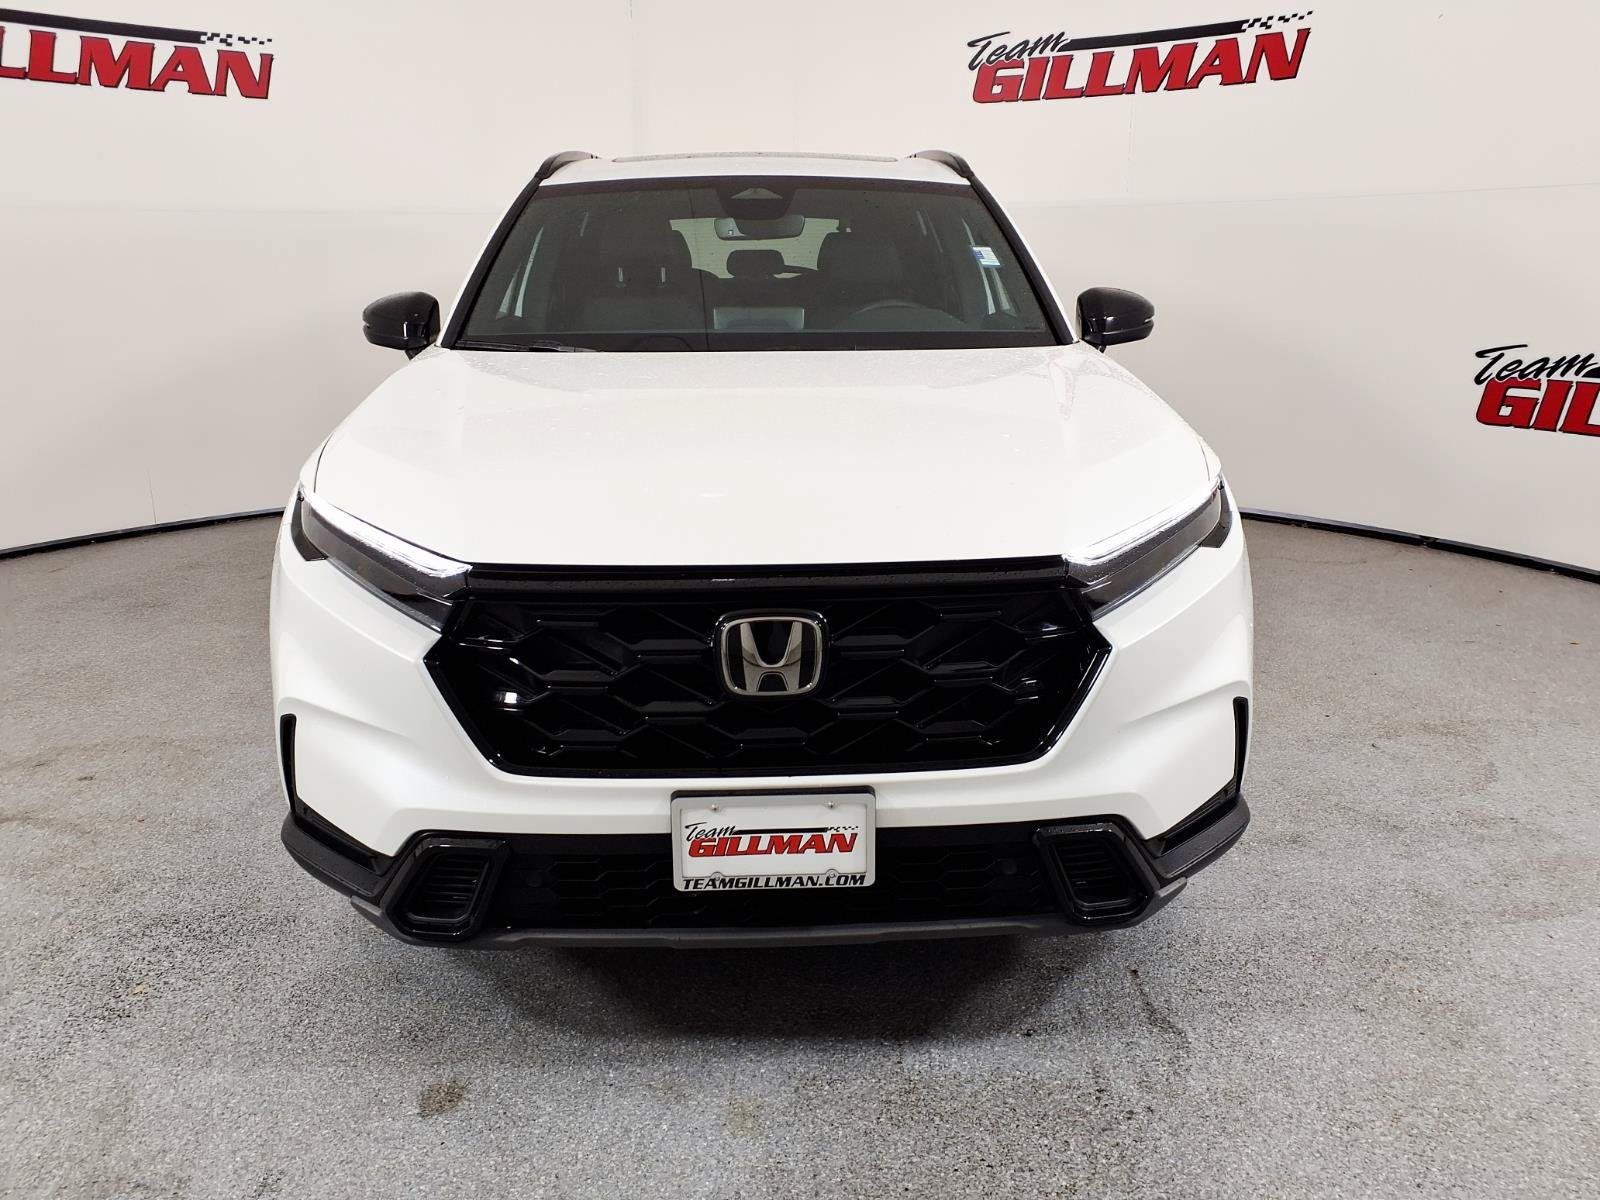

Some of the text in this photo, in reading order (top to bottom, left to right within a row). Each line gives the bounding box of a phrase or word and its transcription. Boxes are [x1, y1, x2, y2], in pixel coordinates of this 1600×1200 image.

[967, 31, 1072, 71] Team
[972, 28, 1311, 103] GILLMAN
[1474, 344, 1599, 385] Team
[684, 822, 736, 841] Team
[688, 832, 858, 858] GILLMAN
[683, 874, 866, 890] TEAMGILLMAN.COM
